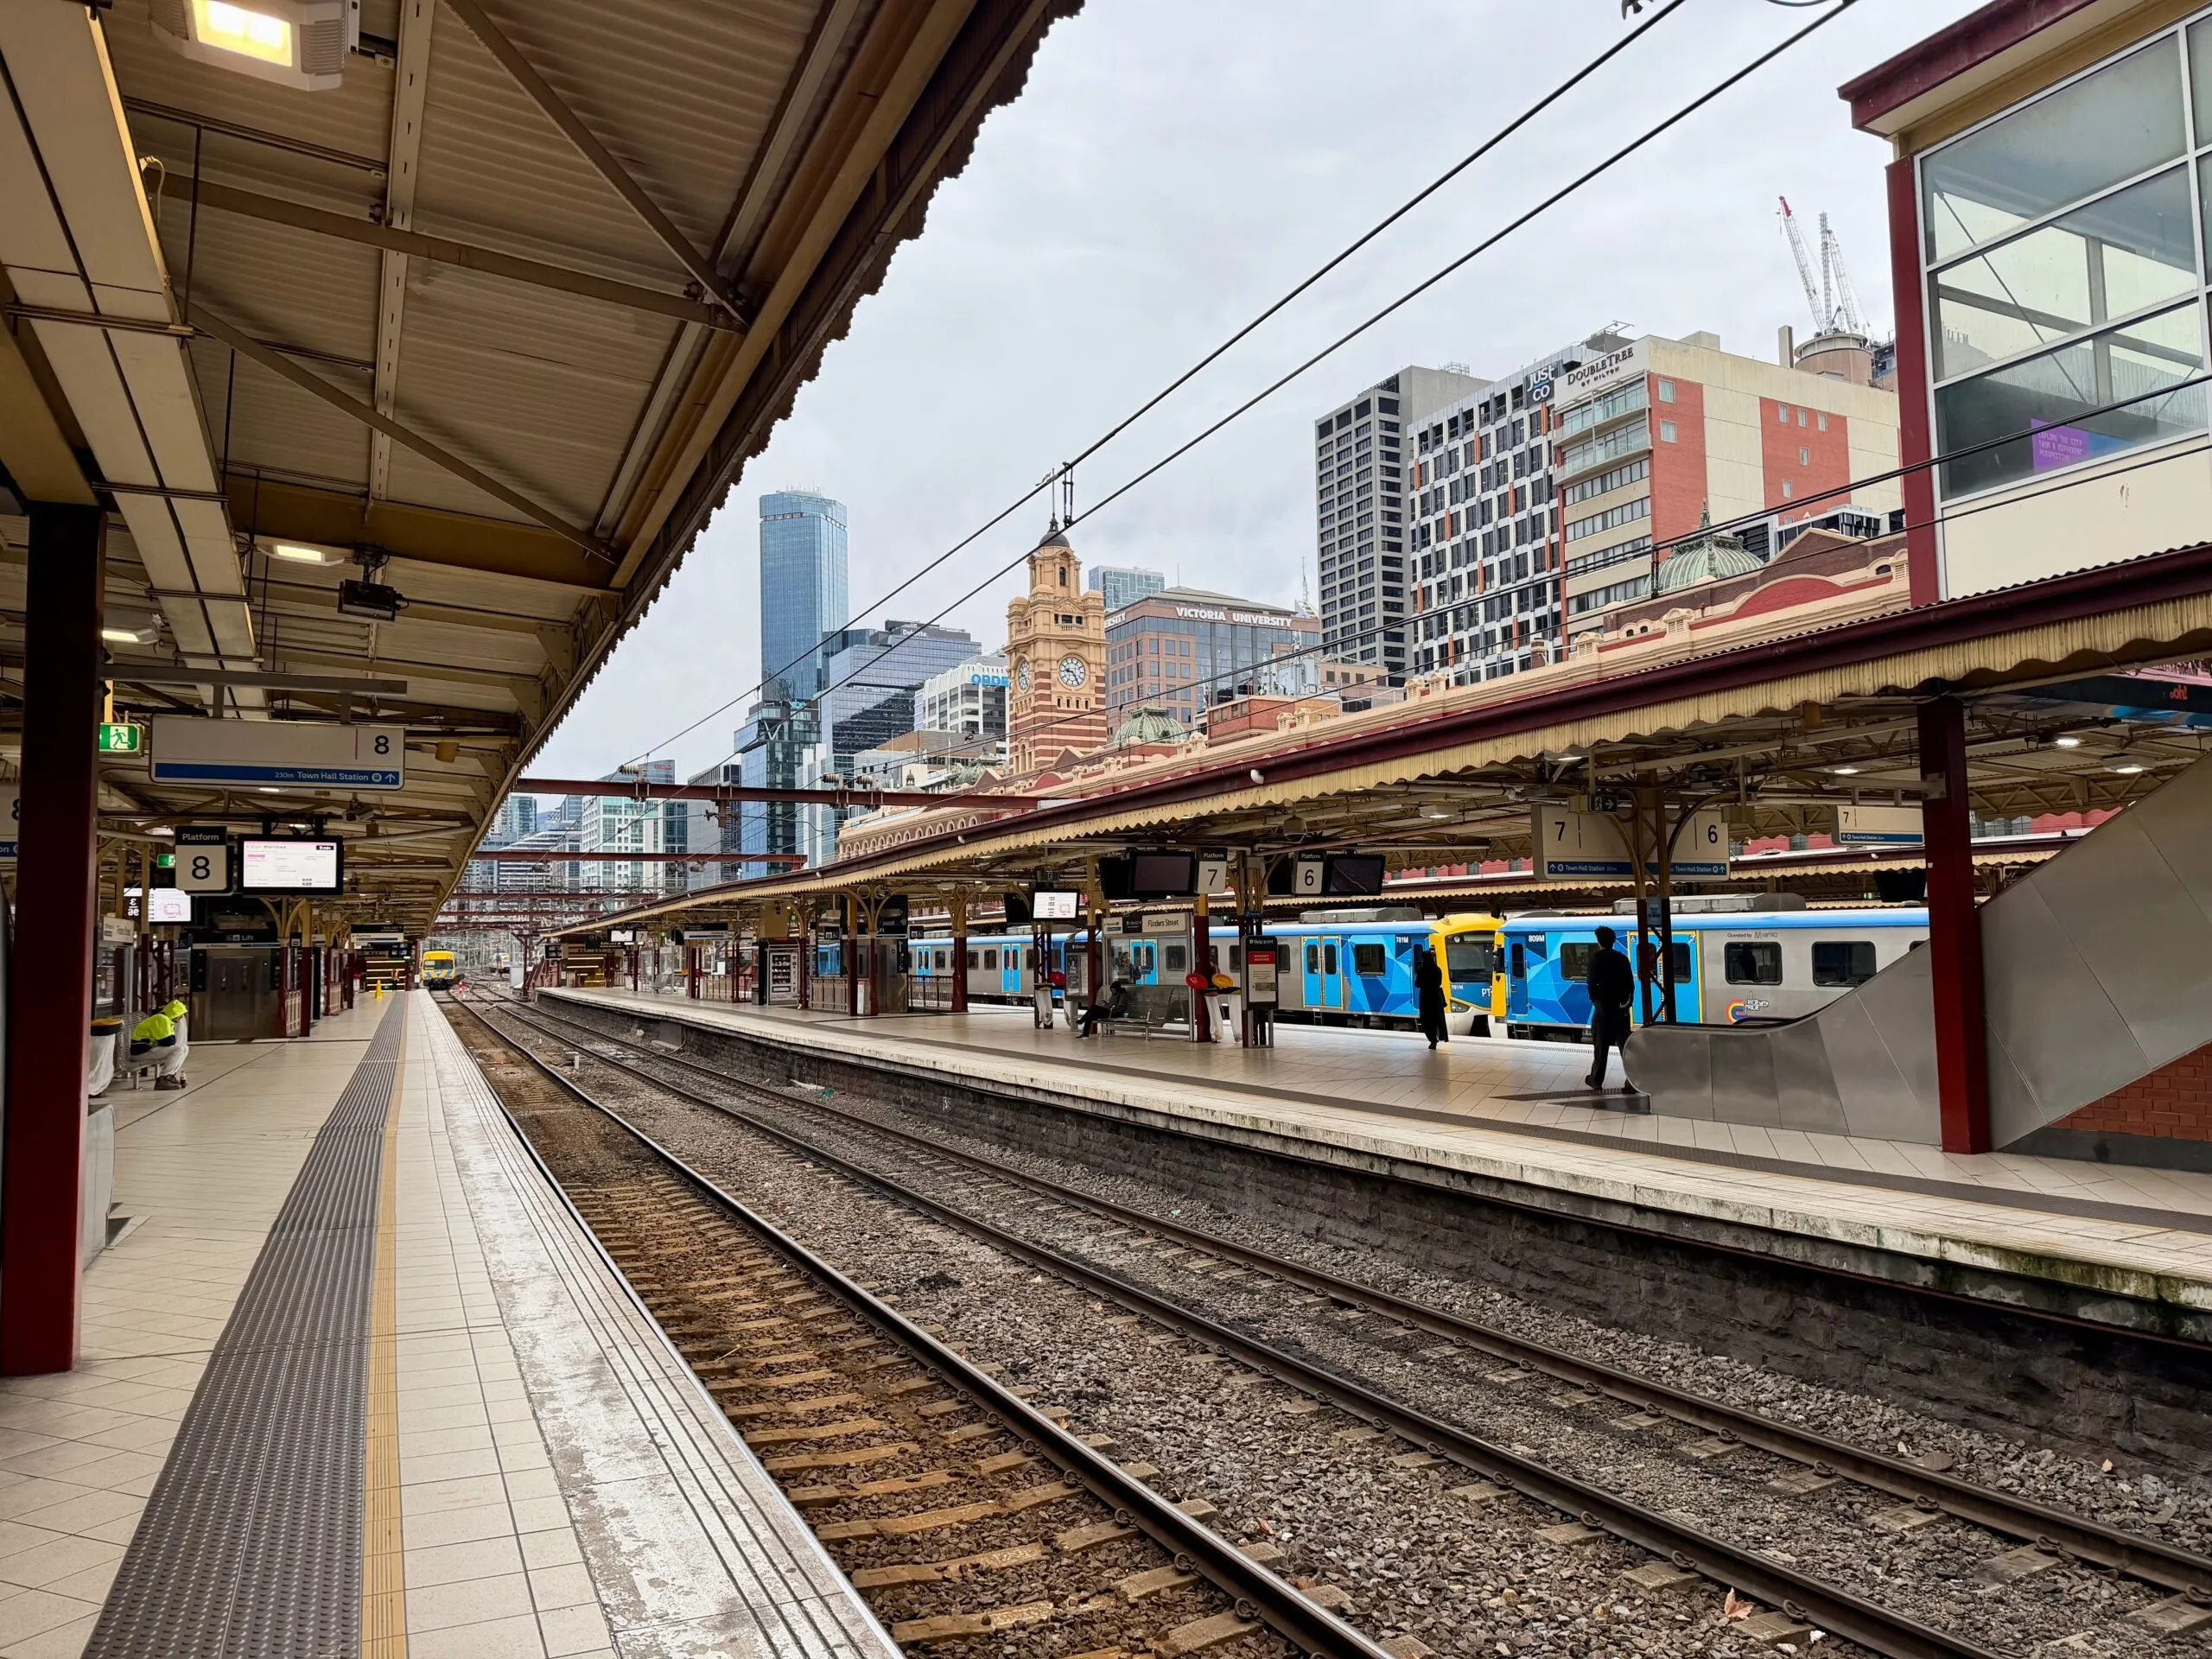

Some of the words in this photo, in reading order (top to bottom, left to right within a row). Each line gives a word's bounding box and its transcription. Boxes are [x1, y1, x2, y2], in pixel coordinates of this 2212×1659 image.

[1593, 366, 1620, 381] HILTON
[1176, 607, 1226, 621] VICTORIA
[1232, 613, 1293, 627] UNIVERSITY
[374, 734, 390, 755] 8
[296, 771, 320, 780] Town
[321, 772, 337, 781] Hall
[1843, 811, 1849, 823] 7
[182, 833, 219, 842] Platform
[1554, 821, 1566, 842] 7
[1707, 824, 1719, 844] 6
[192, 855, 211, 880] 8
[1207, 868, 1218, 887] 7
[1304, 868, 1314, 887] 6
[1481, 988, 1492, 997] PT
